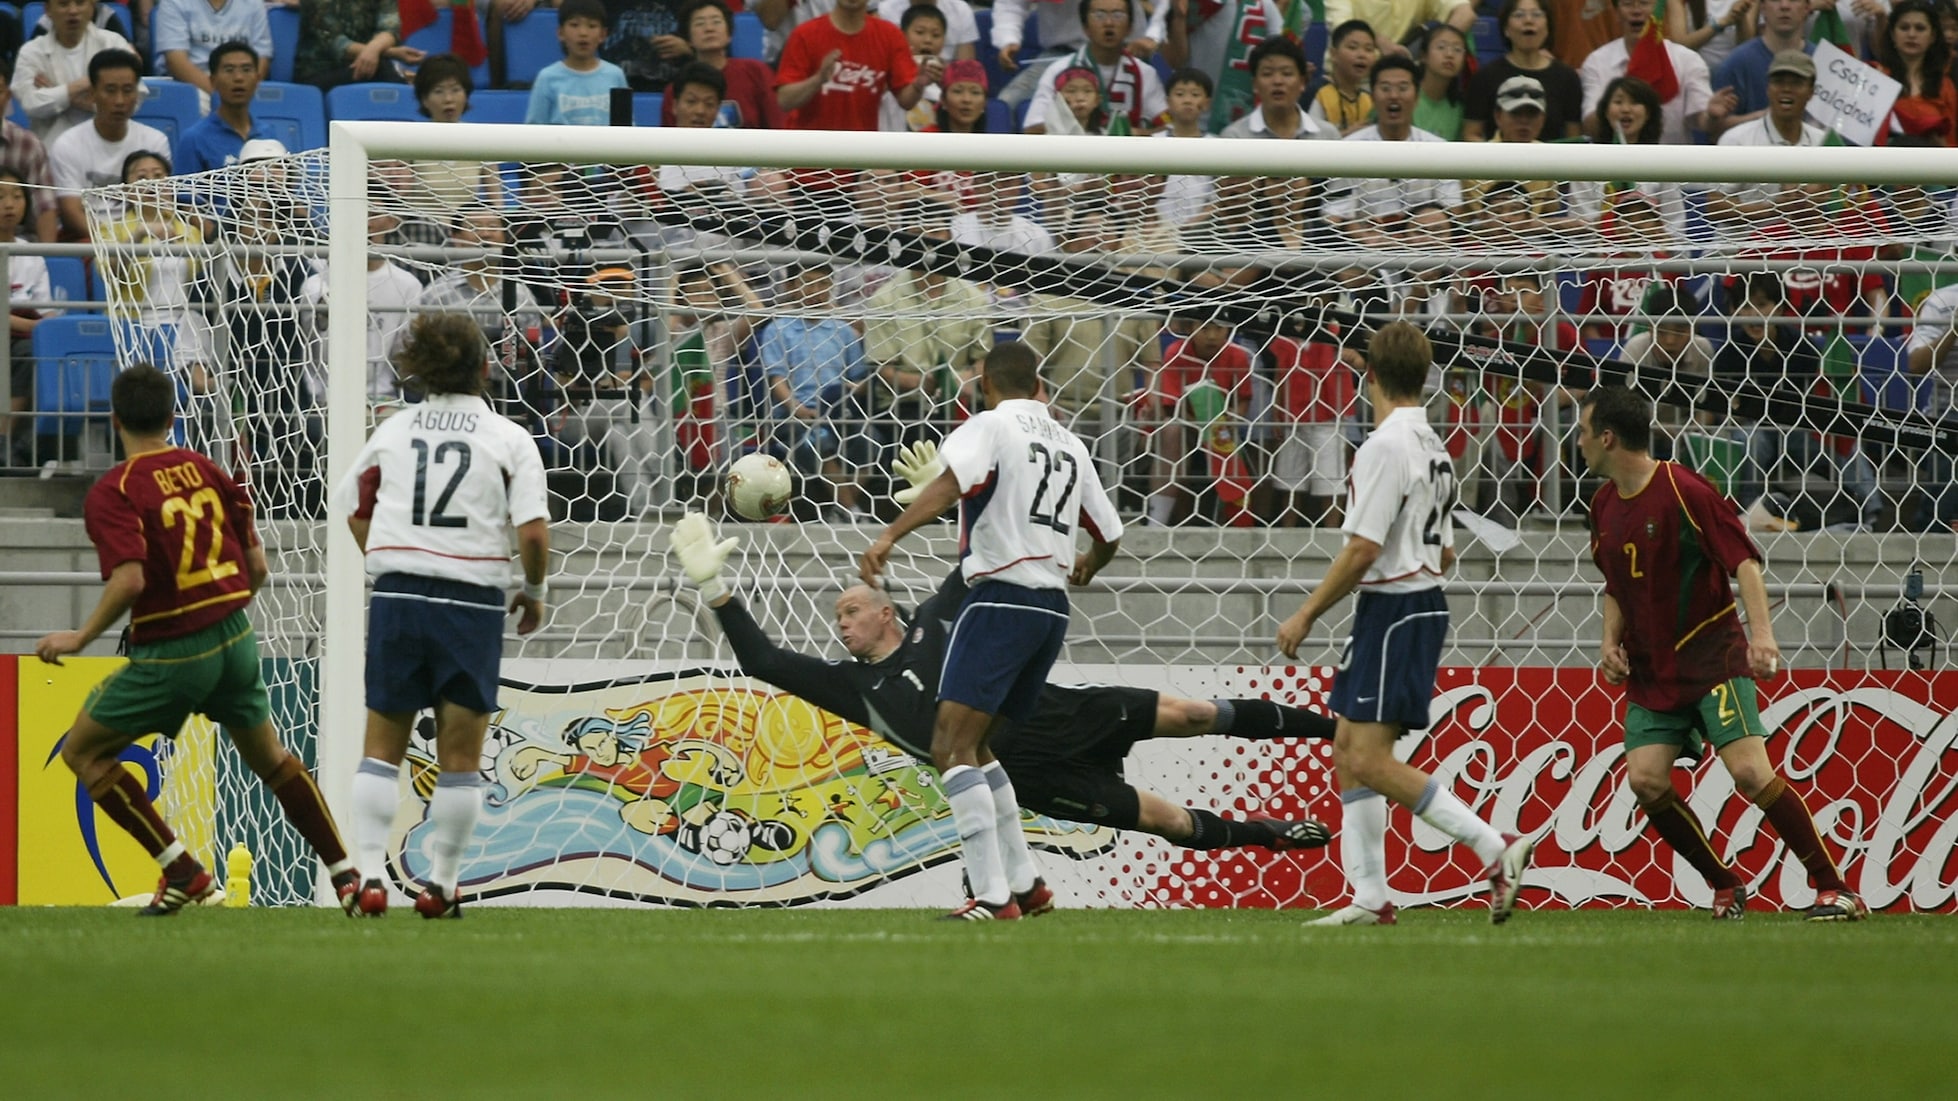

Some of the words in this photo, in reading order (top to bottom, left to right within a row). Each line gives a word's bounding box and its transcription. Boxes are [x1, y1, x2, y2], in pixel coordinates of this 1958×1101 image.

[410, 409, 479, 433] AGOOS
[152, 461, 203, 495] BETO
[410, 438, 471, 528] 12
[1028, 441, 1077, 536] 22
[161, 486, 240, 590] 22
[1623, 542, 1644, 578] 2
[902, 669, 925, 692] 1
[1710, 683, 1736, 720] 2
